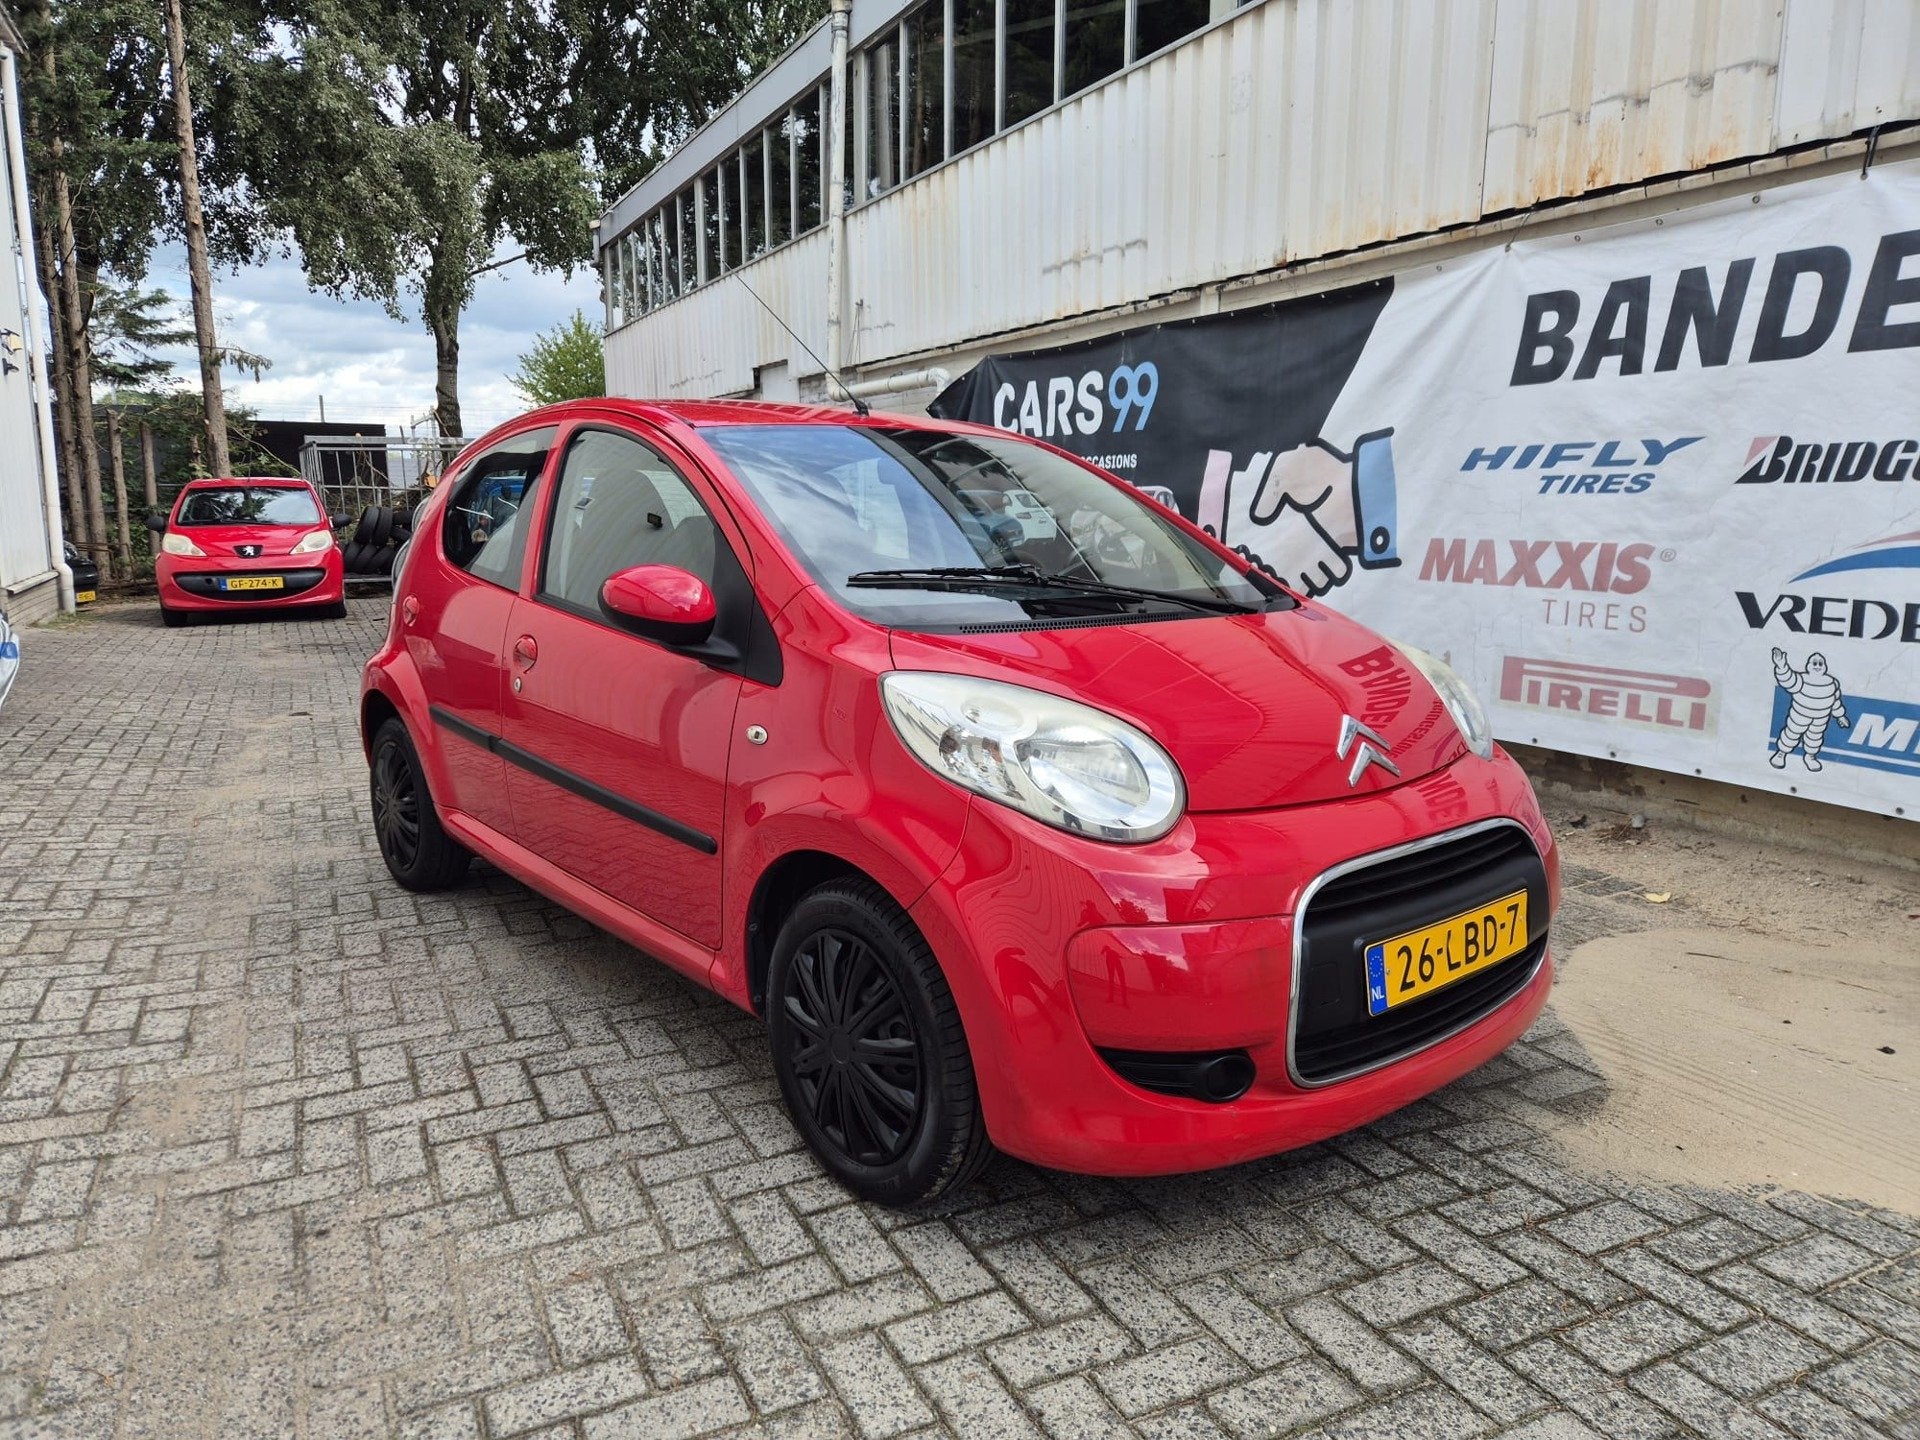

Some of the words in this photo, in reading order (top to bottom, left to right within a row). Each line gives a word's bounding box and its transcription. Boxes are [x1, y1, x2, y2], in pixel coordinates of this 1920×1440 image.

[1509, 229, 1920, 387] BANDE
[1459, 436, 1707, 472] HIFLY
[1734, 435, 1920, 485] BRIDG
[1538, 472, 1656, 494] TIRES
[230, 579, 279, 589] GF-274-K
[1418, 537, 1656, 595] MAXXIS
[1542, 598, 1647, 633] TIRES
[1500, 655, 1712, 731] PIRELLI
[1371, 985, 1385, 1002] NL
[1396, 903, 1520, 993] 26-LBD-7
